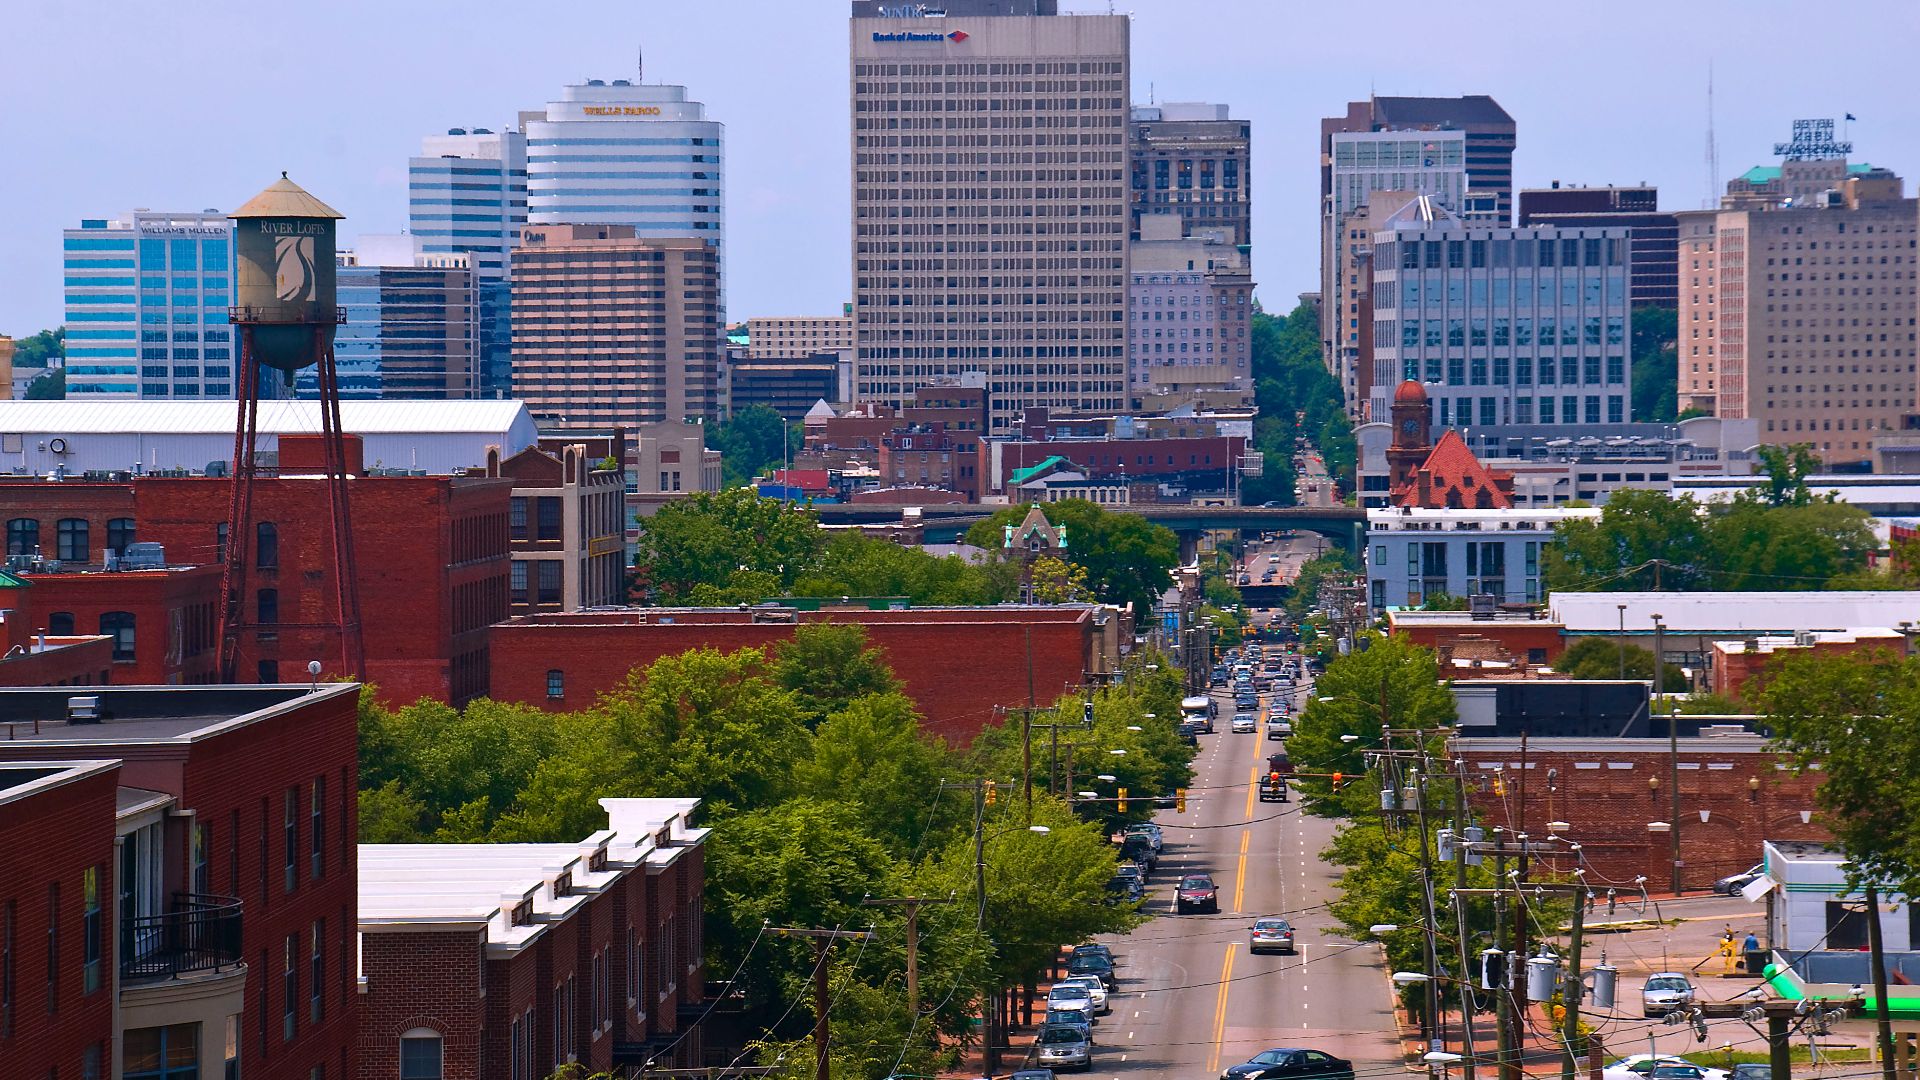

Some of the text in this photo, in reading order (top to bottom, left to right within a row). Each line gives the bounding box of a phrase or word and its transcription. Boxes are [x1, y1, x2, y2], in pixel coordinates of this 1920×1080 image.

[873, 32, 944, 41] Bank of America
[583, 106, 660, 116] WELLS FARGO
[260, 220, 325, 234] RIVER LOFTS
